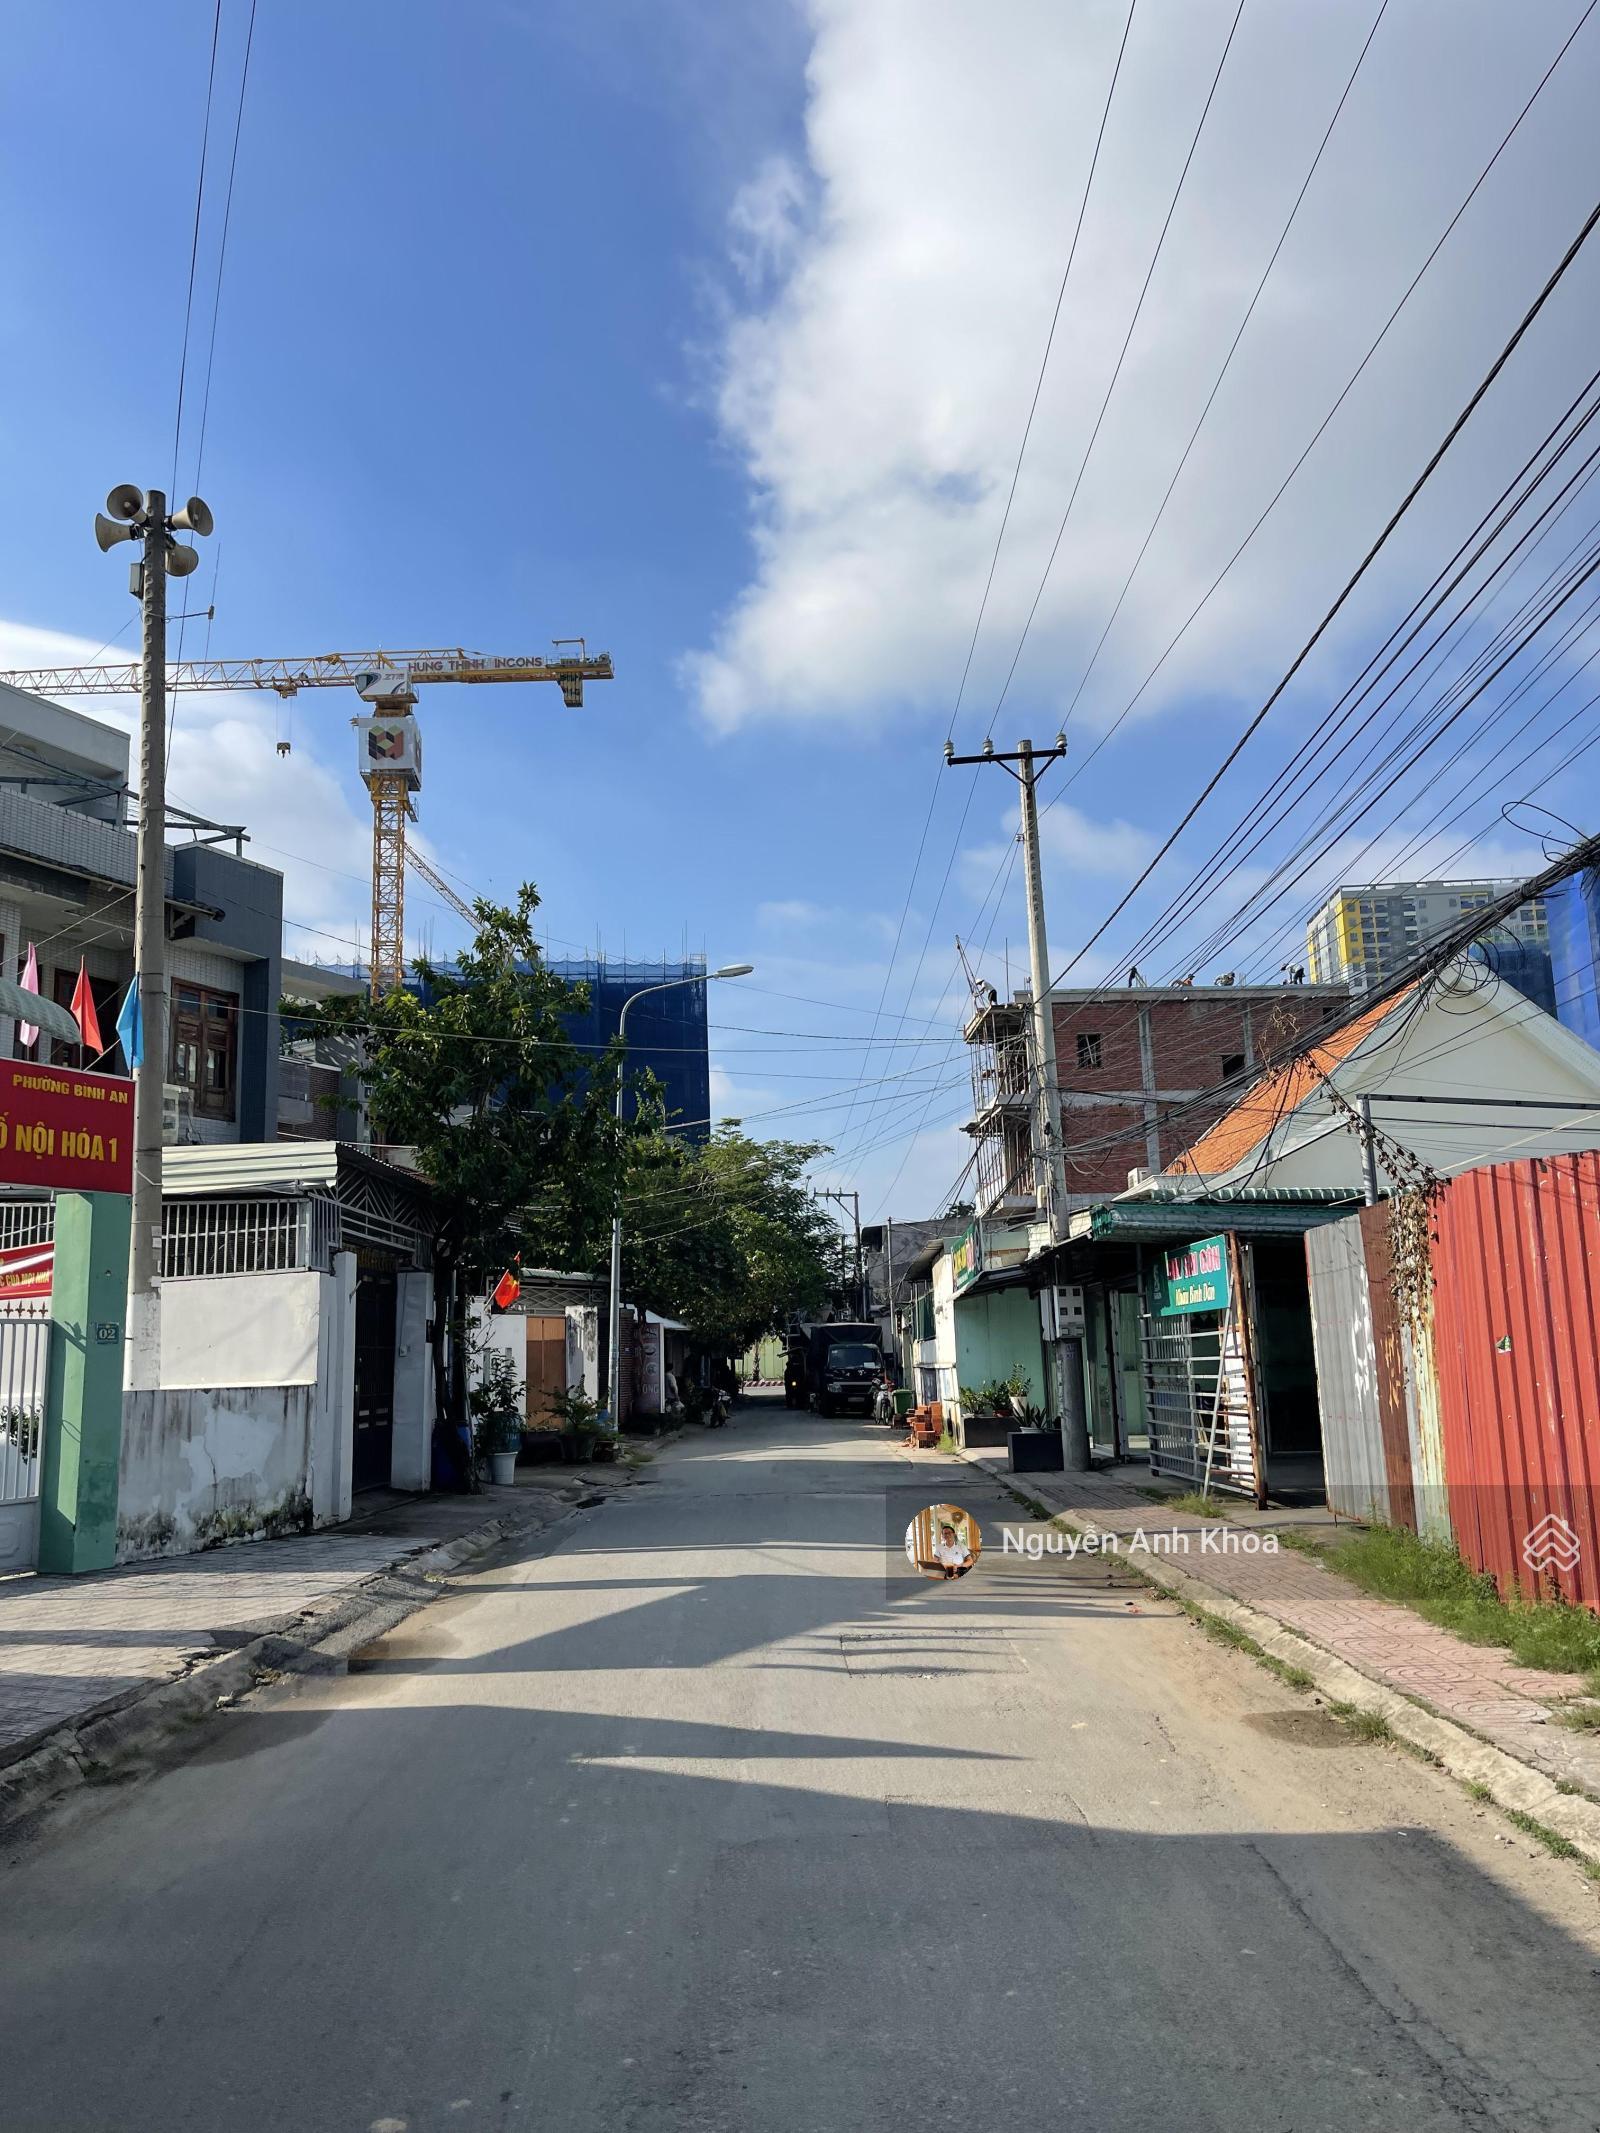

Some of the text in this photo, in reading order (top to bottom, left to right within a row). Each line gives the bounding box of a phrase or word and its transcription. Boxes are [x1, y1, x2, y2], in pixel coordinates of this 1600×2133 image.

[494, 656, 543, 668] INCONS
[109, 1092, 129, 1104] AN
[15, 1121, 55, 1160] NỘI
[61, 1127, 105, 1161] HÓA
[108, 1137, 118, 1163] 1
[98, 1328, 116, 1339] 02
